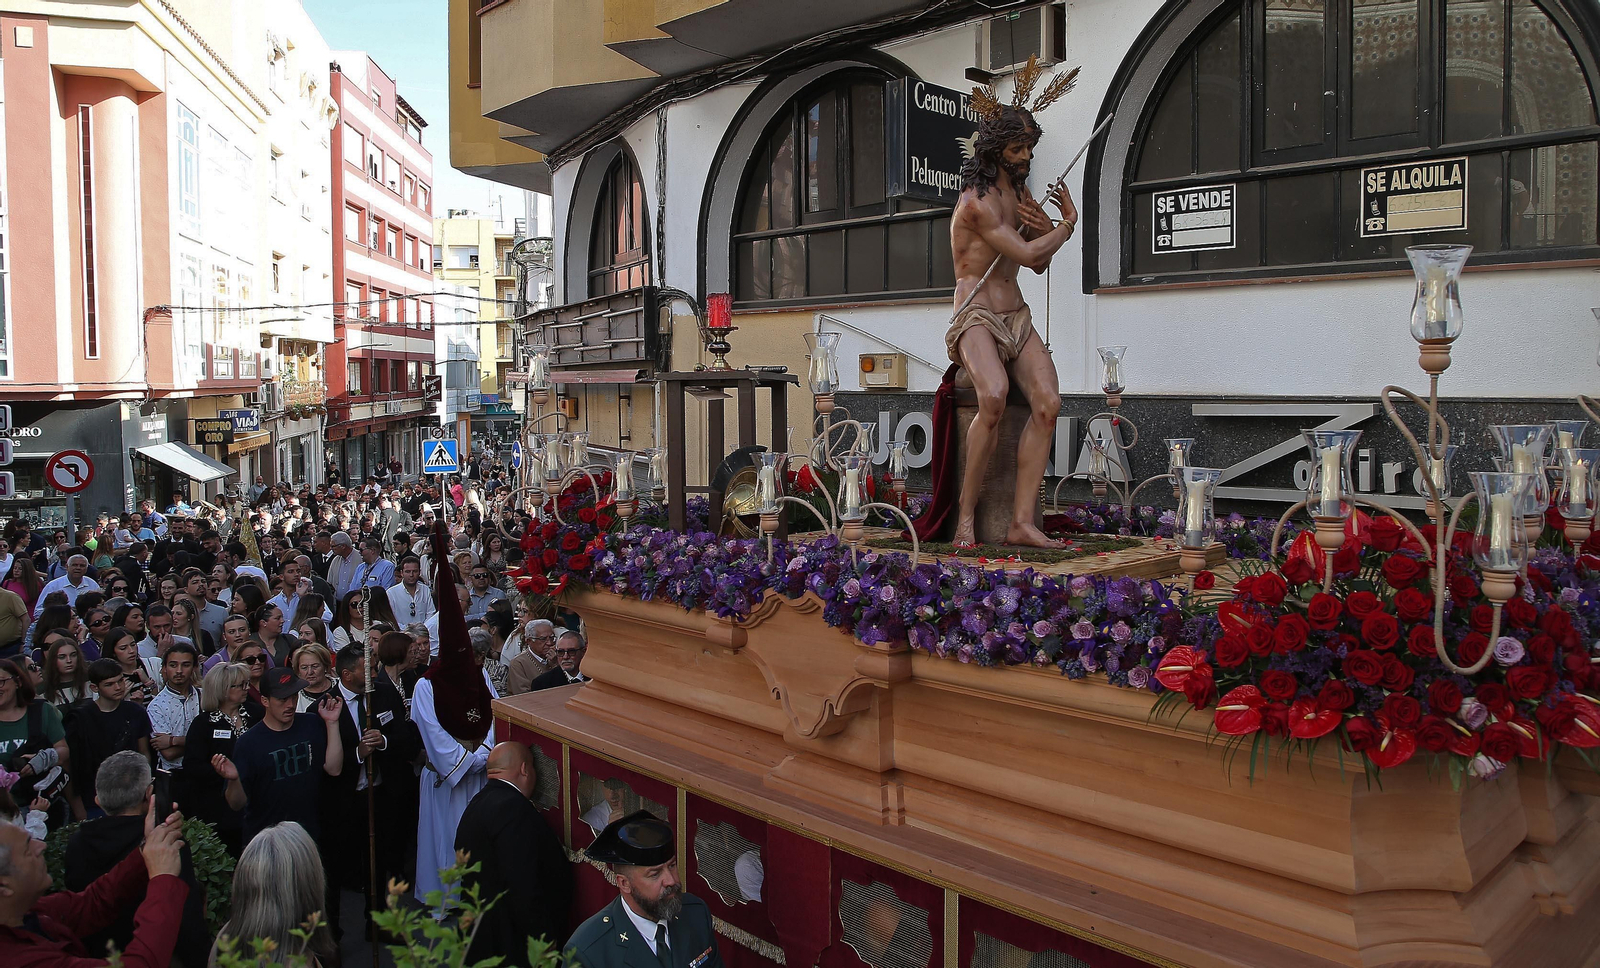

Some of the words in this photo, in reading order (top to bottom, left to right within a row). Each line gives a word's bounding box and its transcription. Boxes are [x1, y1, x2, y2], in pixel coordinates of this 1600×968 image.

[914, 81, 956, 117] Centro
[911, 155, 963, 197] Peluquerí
[1367, 171, 1386, 194] SE
[1390, 163, 1462, 190] ALQUILA
[1157, 195, 1175, 214] SE
[1179, 190, 1231, 211] VENDE
[196, 420, 232, 432] COMPRO
[204, 432, 224, 443] ORO
